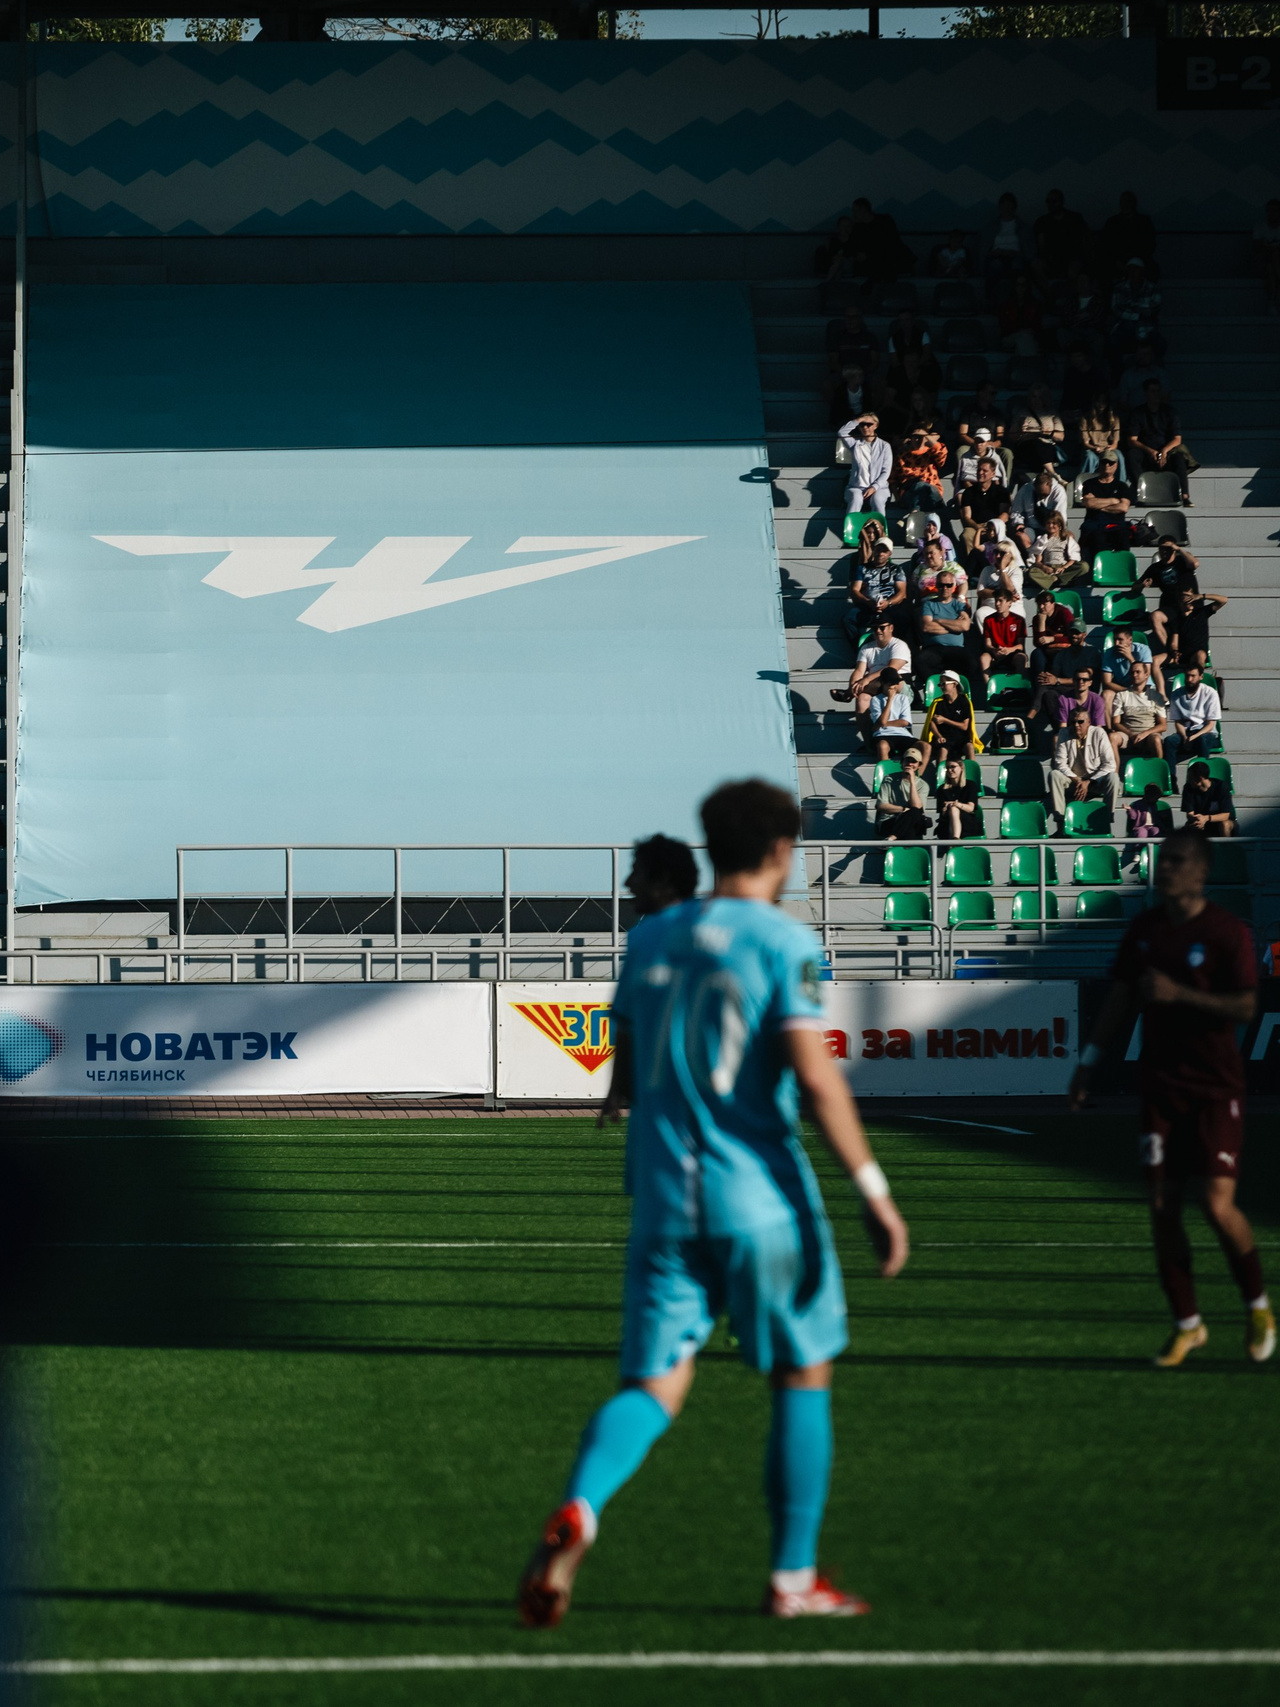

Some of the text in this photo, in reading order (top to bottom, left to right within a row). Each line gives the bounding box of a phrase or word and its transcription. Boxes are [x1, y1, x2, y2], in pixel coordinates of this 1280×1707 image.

[85, 1031, 298, 1062] НОВАТЭК
[861, 1028, 913, 1059] за
[926, 1016, 1068, 1059] нами!
[86, 1069, 186, 1082] ЧЕЛЯБИНСК
